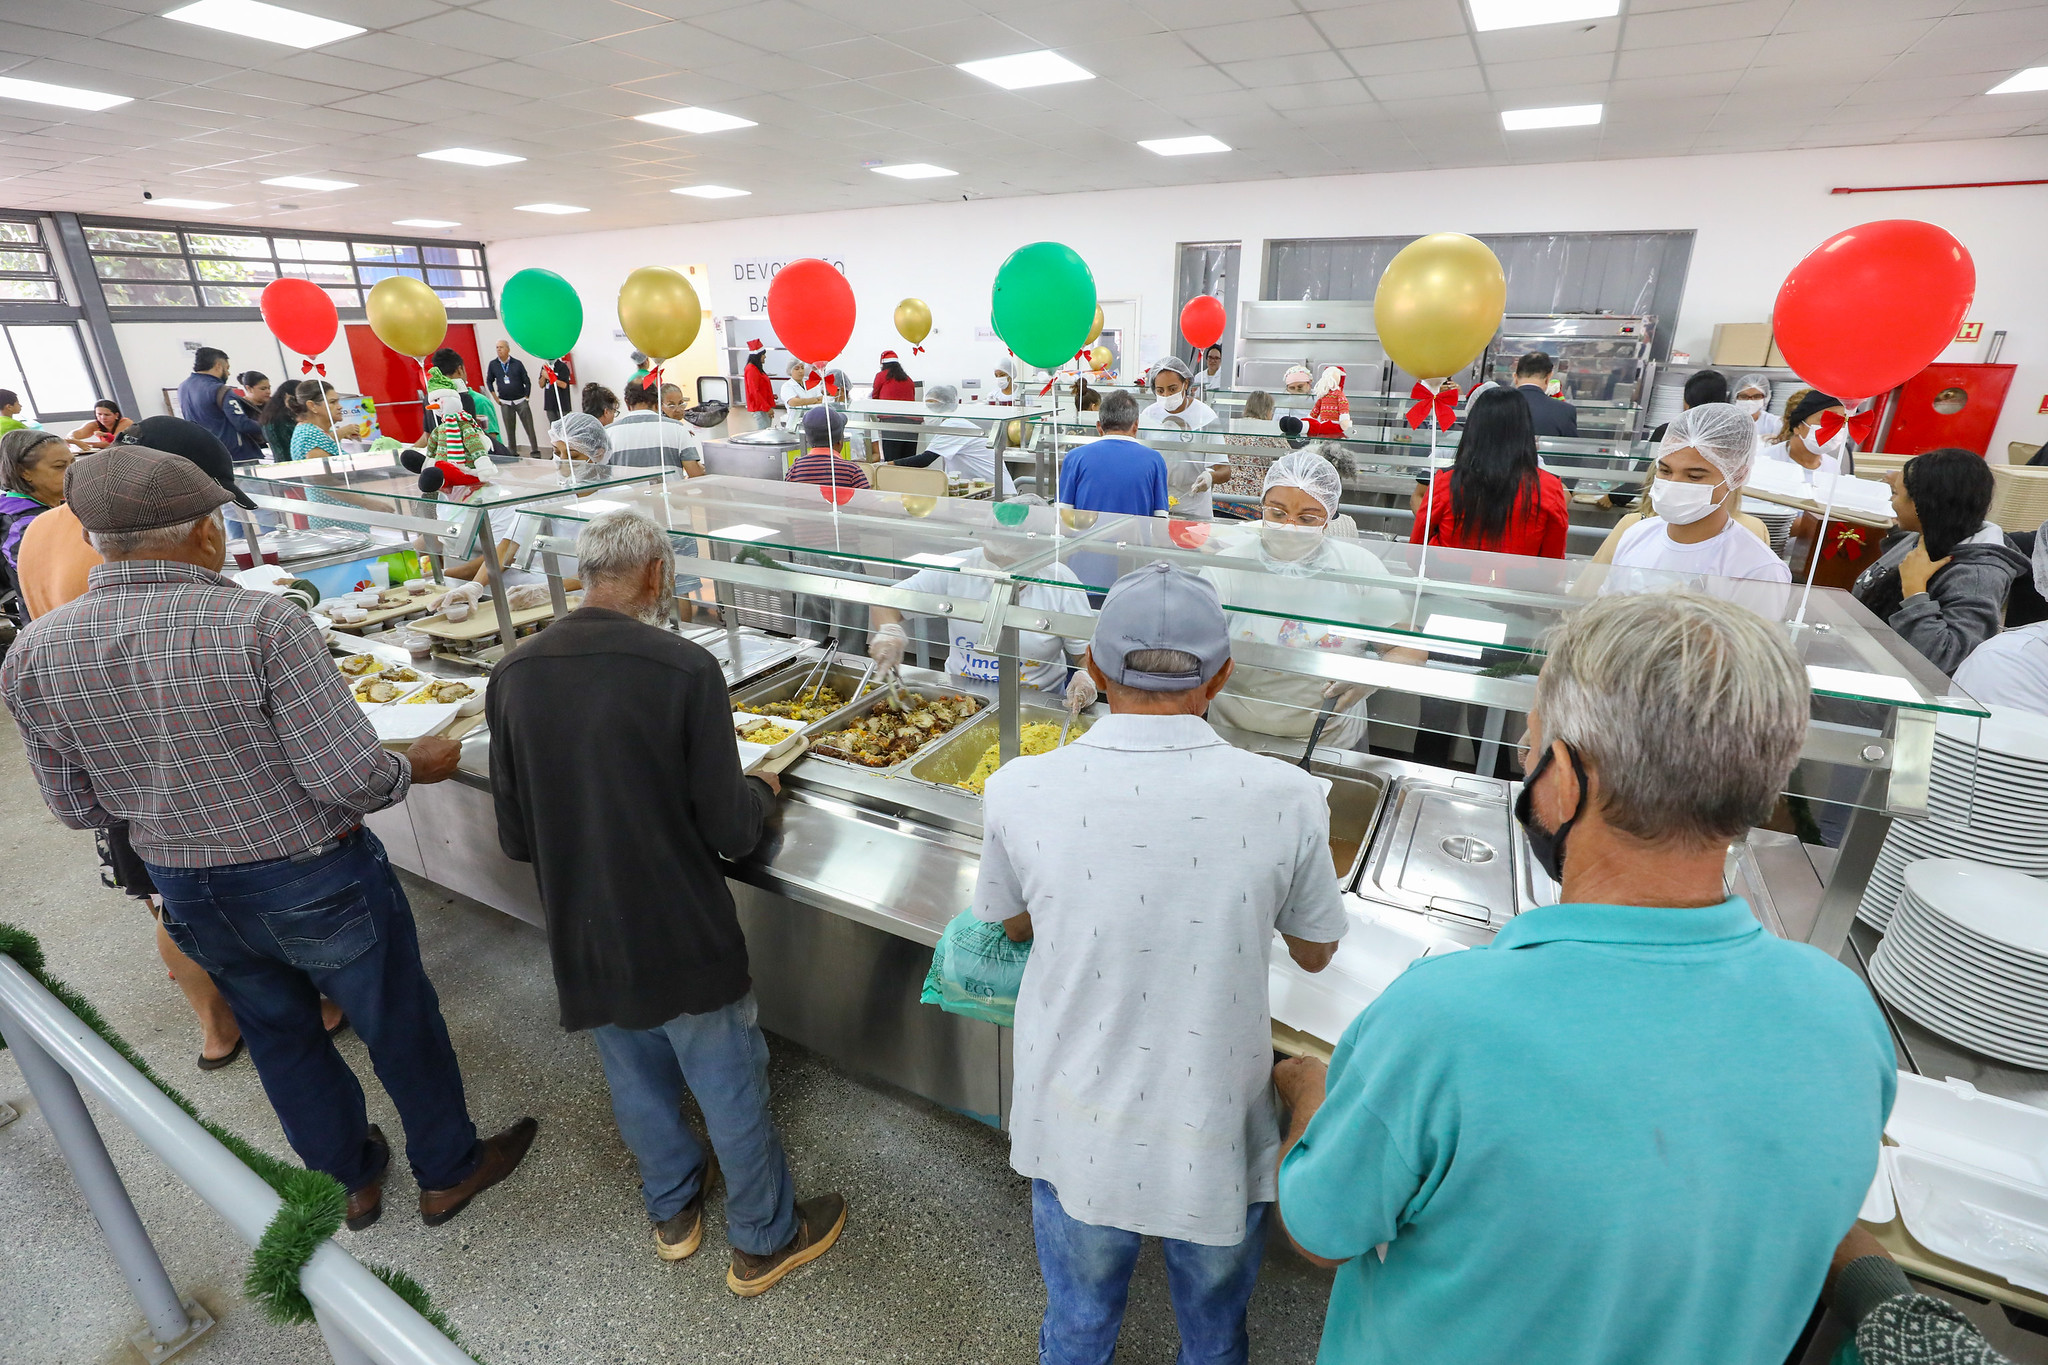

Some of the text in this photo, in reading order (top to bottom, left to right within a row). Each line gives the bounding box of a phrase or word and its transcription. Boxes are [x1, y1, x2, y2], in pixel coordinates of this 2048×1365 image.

[734, 258, 845, 280] DEVOO
[1960, 323, 1980, 337] H
[228, 399, 244, 415] 3
[965, 981, 996, 998] ECO
